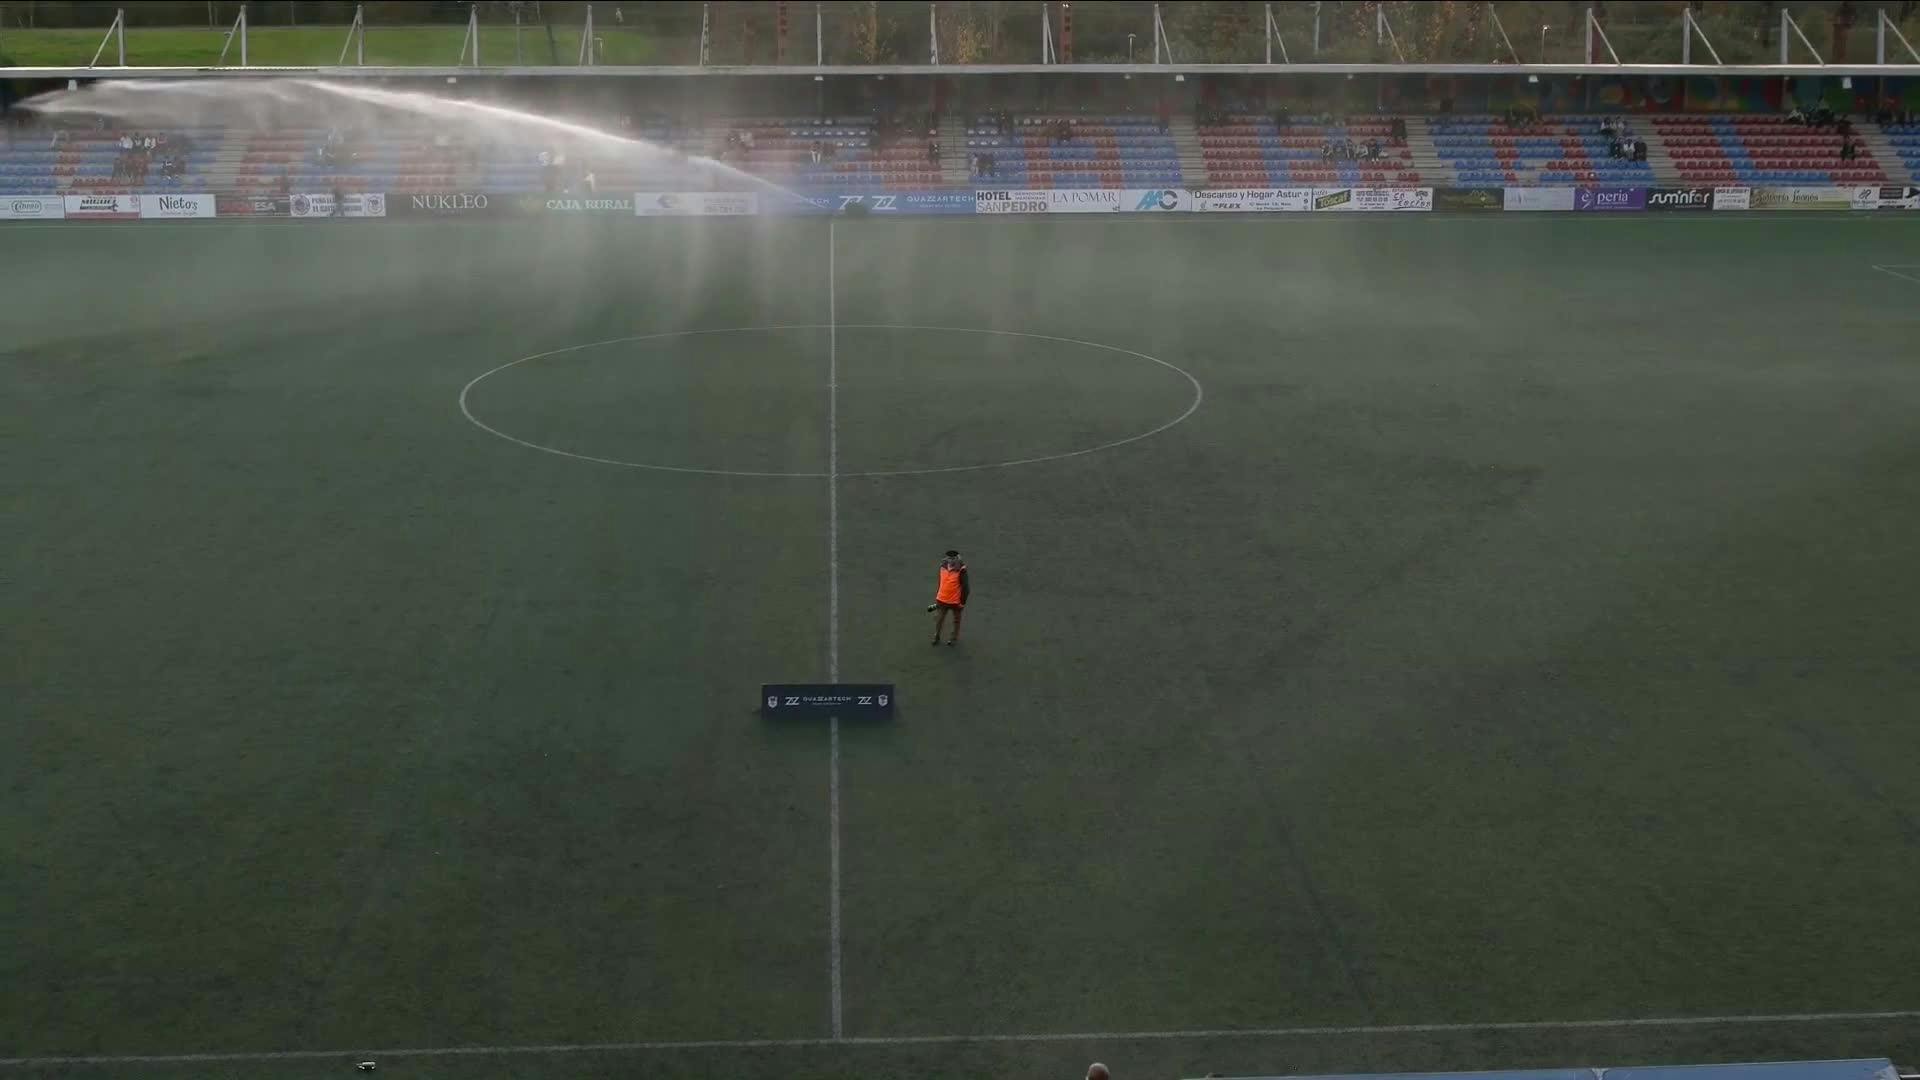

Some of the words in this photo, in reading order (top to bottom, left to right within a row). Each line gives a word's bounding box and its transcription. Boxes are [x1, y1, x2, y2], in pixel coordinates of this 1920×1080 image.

[977, 191, 1012, 200] HOTEL
[1072, 192, 1117, 203] POMAR
[1194, 191, 1238, 199] Descanso
[1247, 190, 1275, 201] Hogar
[1276, 190, 1302, 198] Astur
[159, 196, 198, 210] Nieto's
[412, 194, 488, 209] NUKLEO
[546, 199, 582, 209] CAJA
[585, 199, 632, 209] RURAL
[977, 201, 1047, 212] SANPEDRO
